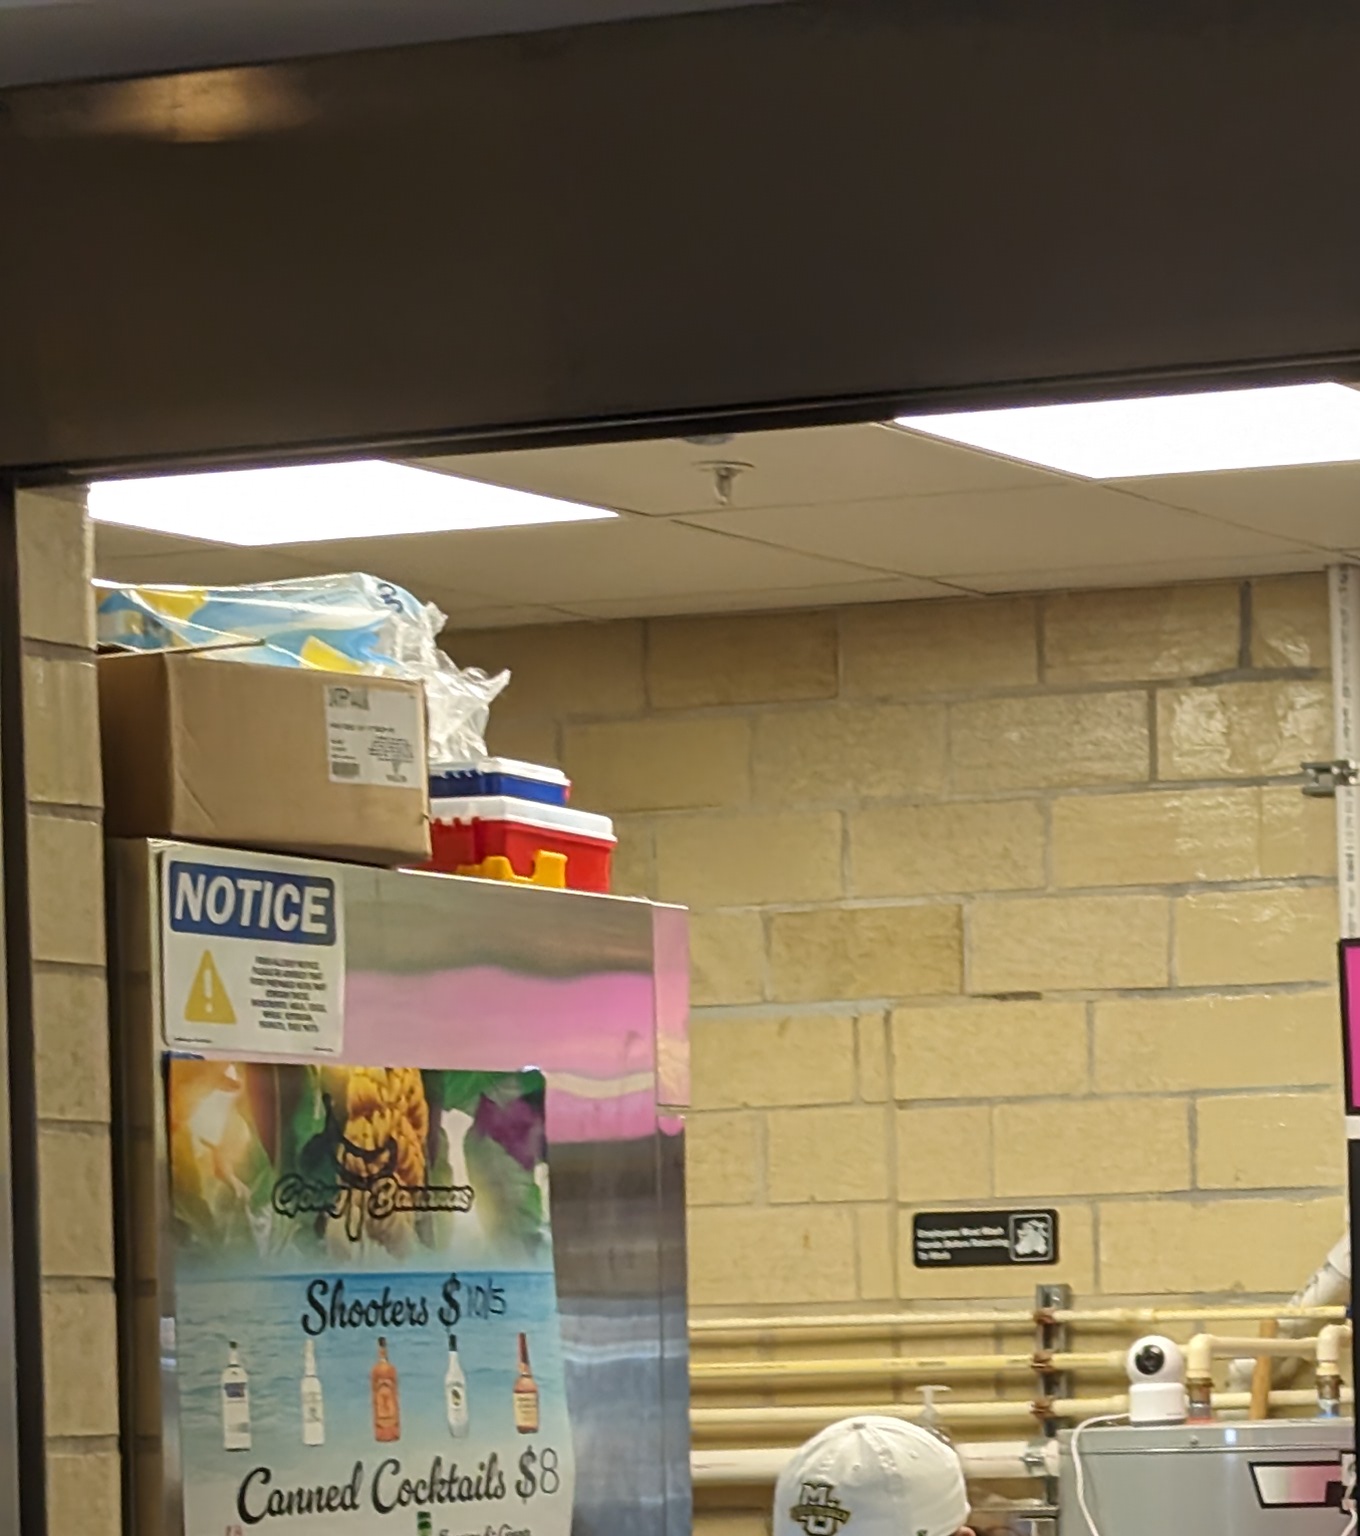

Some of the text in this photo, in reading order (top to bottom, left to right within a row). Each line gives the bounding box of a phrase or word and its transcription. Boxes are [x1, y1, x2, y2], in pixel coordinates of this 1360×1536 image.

[174, 870, 331, 935] NOTICE
[301, 1279, 429, 1336] Shooters
[237, 1461, 363, 1524] Canned
[371, 1452, 506, 1514] Cocktails
